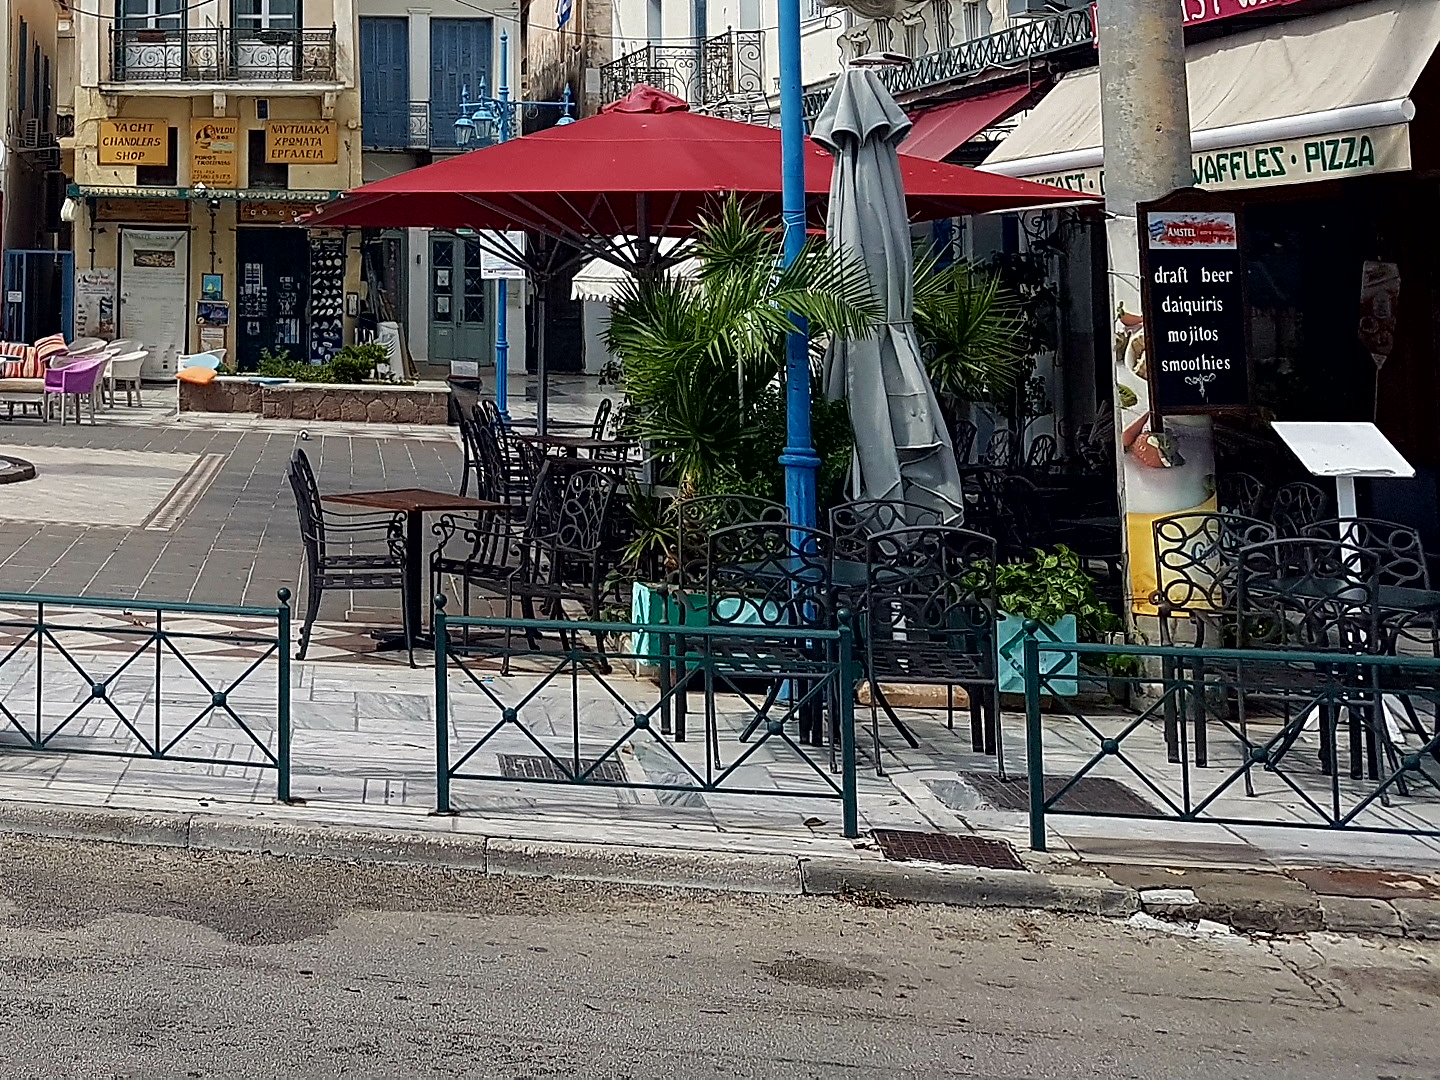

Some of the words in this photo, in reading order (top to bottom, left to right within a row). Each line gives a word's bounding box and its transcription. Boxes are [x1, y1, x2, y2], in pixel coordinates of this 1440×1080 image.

[113, 123, 155, 133] YACHT
[102, 137, 162, 147] CHANDLERS
[274, 137, 322, 146] ΧΡΩΜΑΤΑ
[115, 151, 146, 161] SHOP
[271, 149, 323, 159] ΕΡΓΑΛΕΙΑ
[1304, 135, 1376, 174] PIZZA
[1167, 227, 1197, 237] AMSTEL
[1153, 265, 1189, 284] draft
[1200, 266, 1234, 283] beer
[1161, 295, 1224, 316] daiquiris
[1167, 325, 1219, 346] mojitos
[1161, 353, 1231, 373] smoothies
